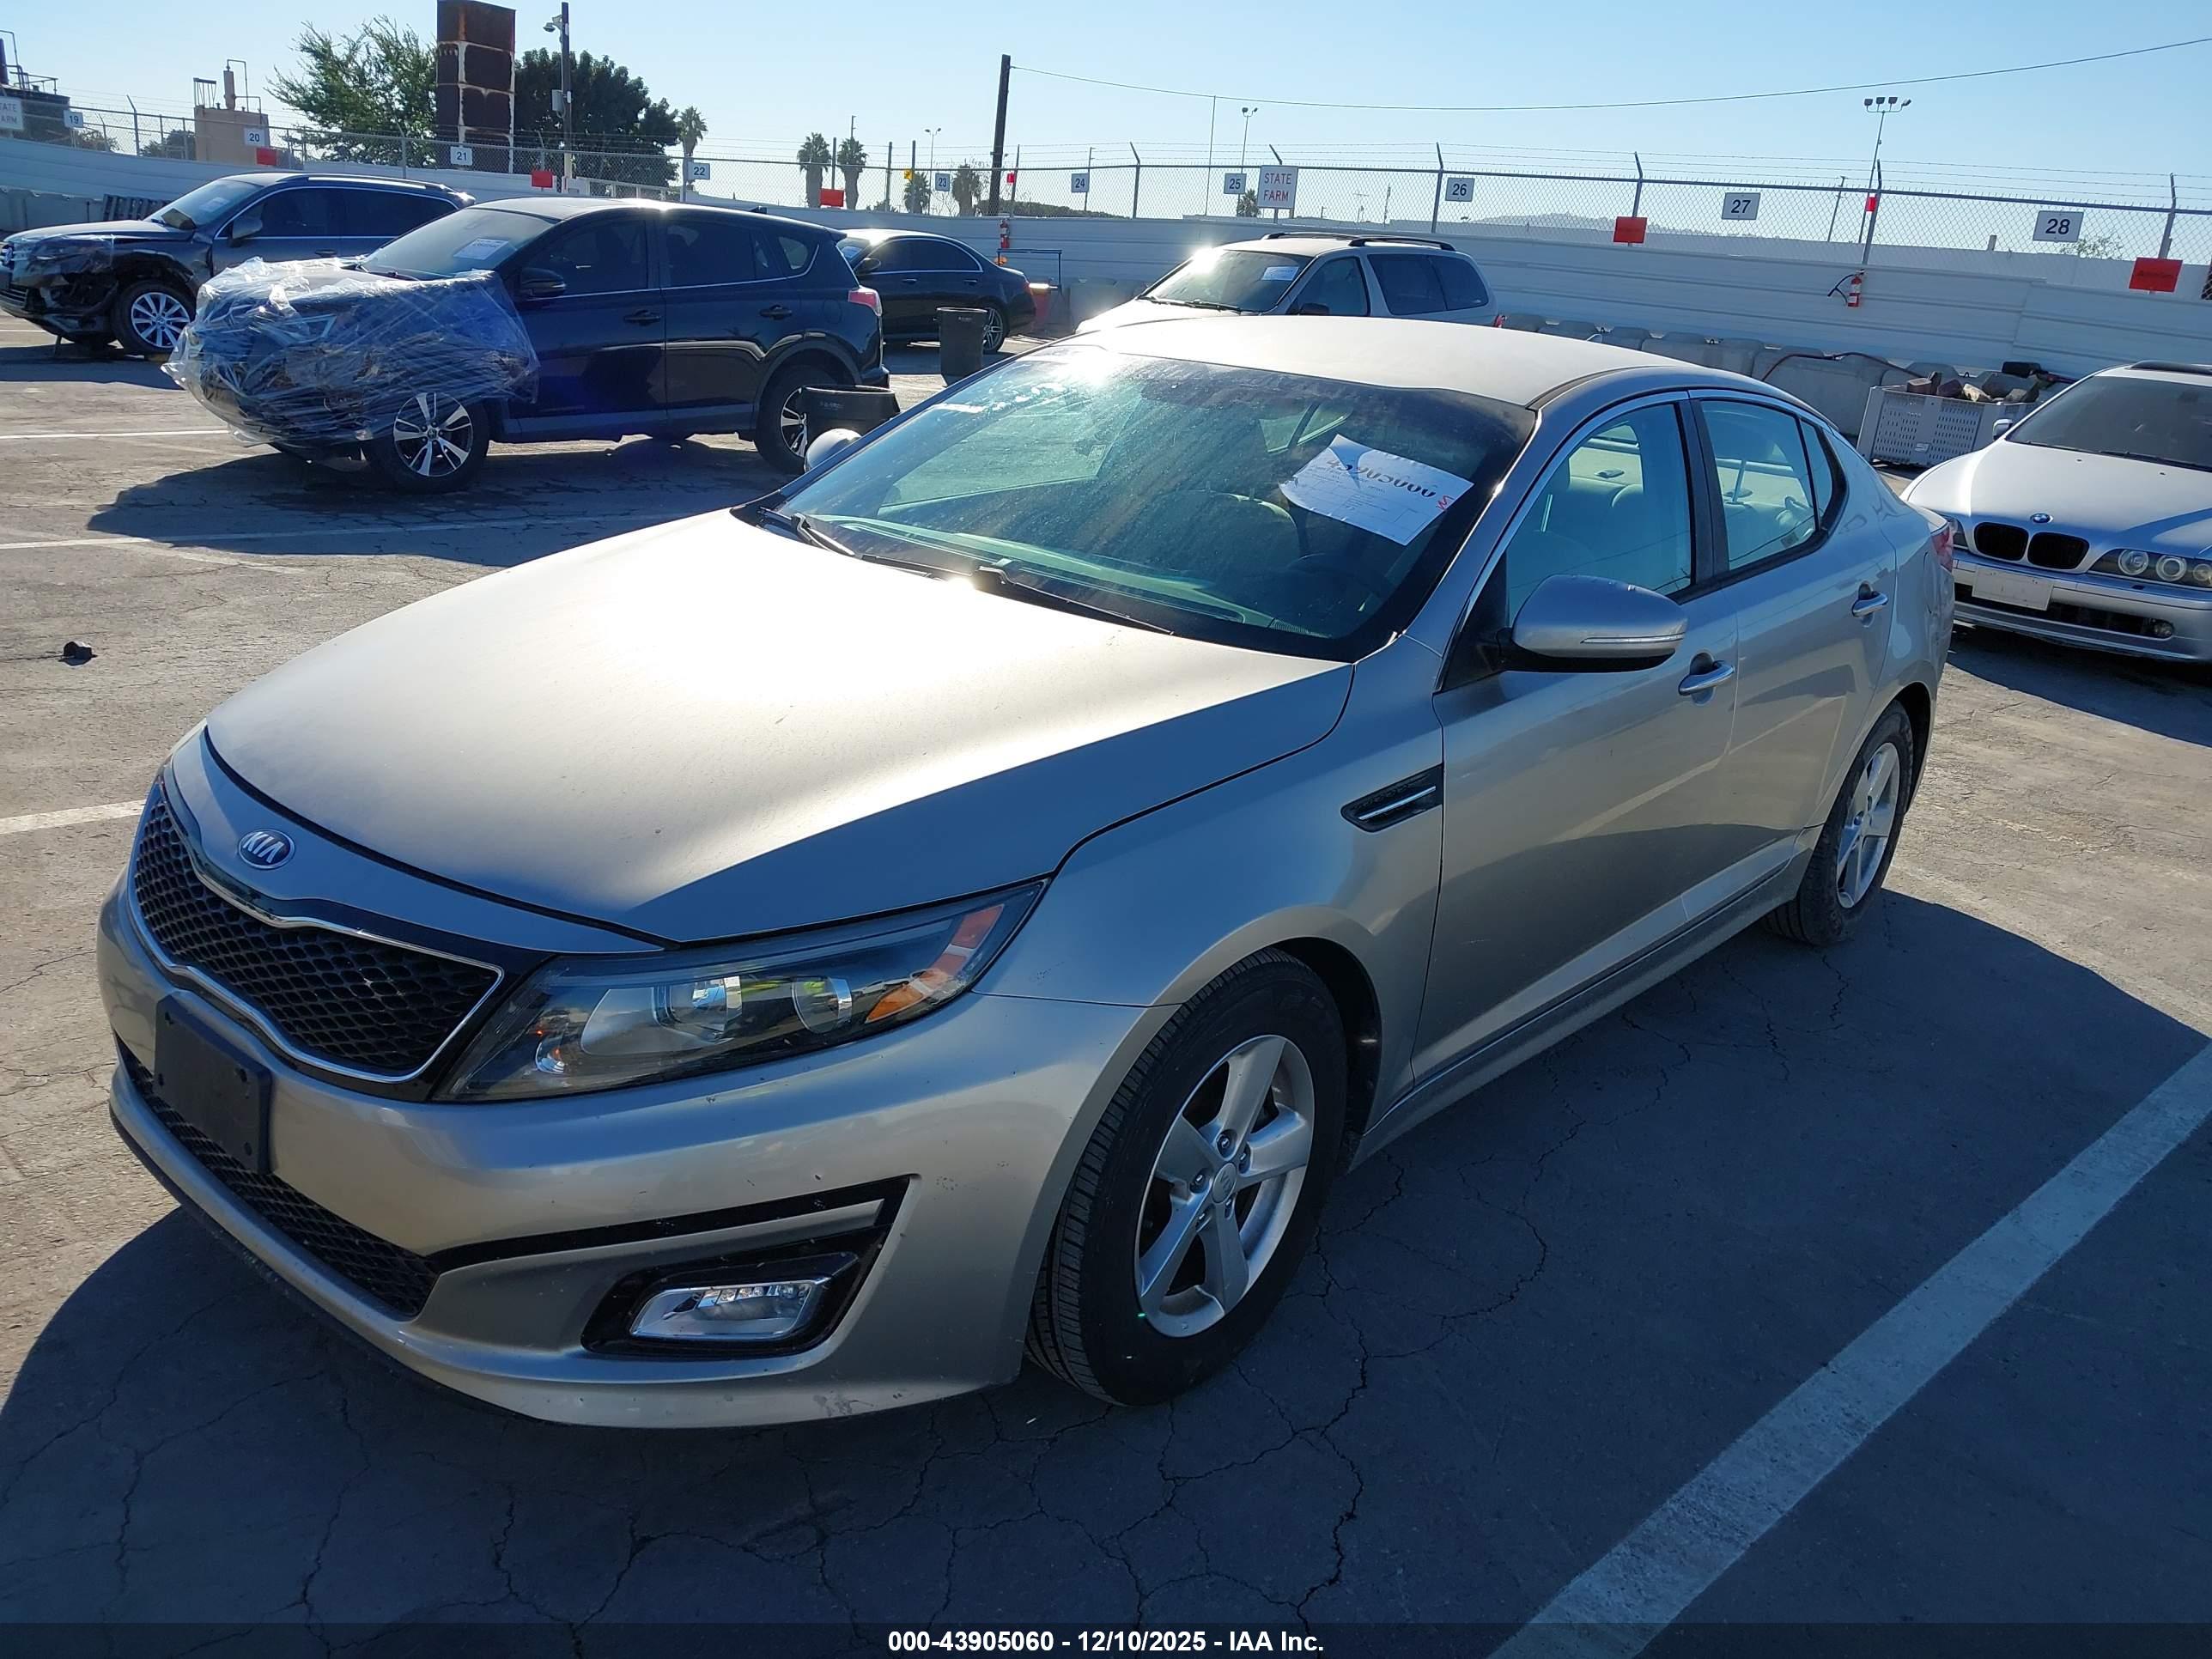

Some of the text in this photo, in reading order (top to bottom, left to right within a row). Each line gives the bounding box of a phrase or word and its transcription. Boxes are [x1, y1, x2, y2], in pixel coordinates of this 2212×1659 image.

[70, 115, 79, 125] 19
[249, 132, 260, 143] 20
[456, 151, 467, 161] 21
[693, 166, 706, 176] 22
[938, 177, 947, 187] 23
[1075, 178, 1085, 188] 24
[1229, 178, 1241, 190] 25
[1264, 173, 1292, 185] STATE
[1263, 189, 1289, 202] FARM
[1452, 183, 1468, 197] 26
[1730, 199, 1752, 214] 27
[2045, 217, 2071, 235] 28
[242, 830, 285, 864] KIA
